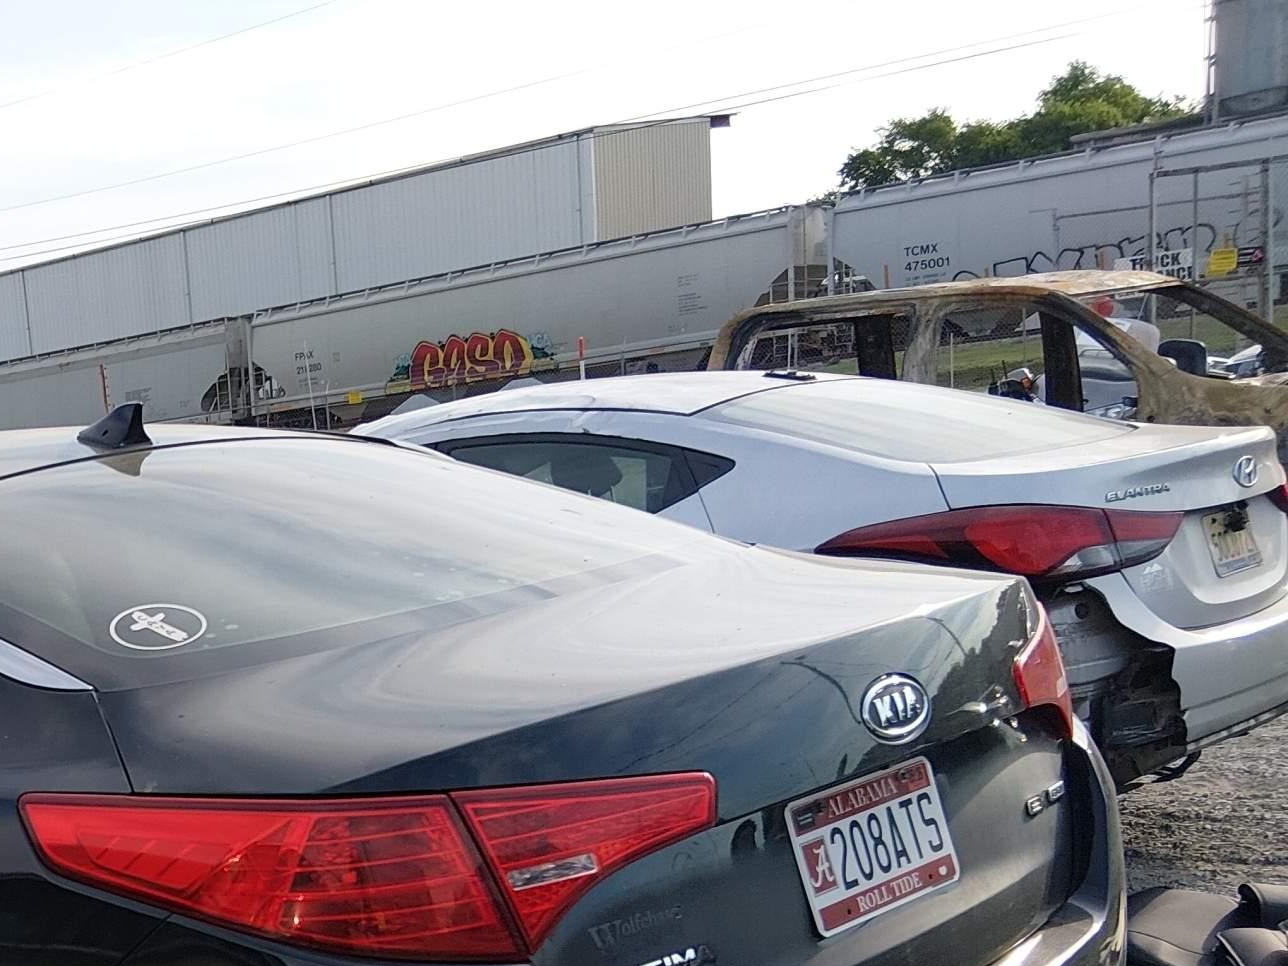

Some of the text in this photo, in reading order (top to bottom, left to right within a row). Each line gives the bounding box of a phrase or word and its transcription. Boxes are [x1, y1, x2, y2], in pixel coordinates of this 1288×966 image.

[904, 243, 938, 257] TCMX
[904, 257, 951, 272] 475001
[1105, 482, 1171, 503] ELANTRA
[872, 685, 921, 727] KIA
[827, 777, 899, 819] ALABAMA
[830, 791, 944, 891] 208ATS
[856, 871, 923, 914] ROLL TIDE
